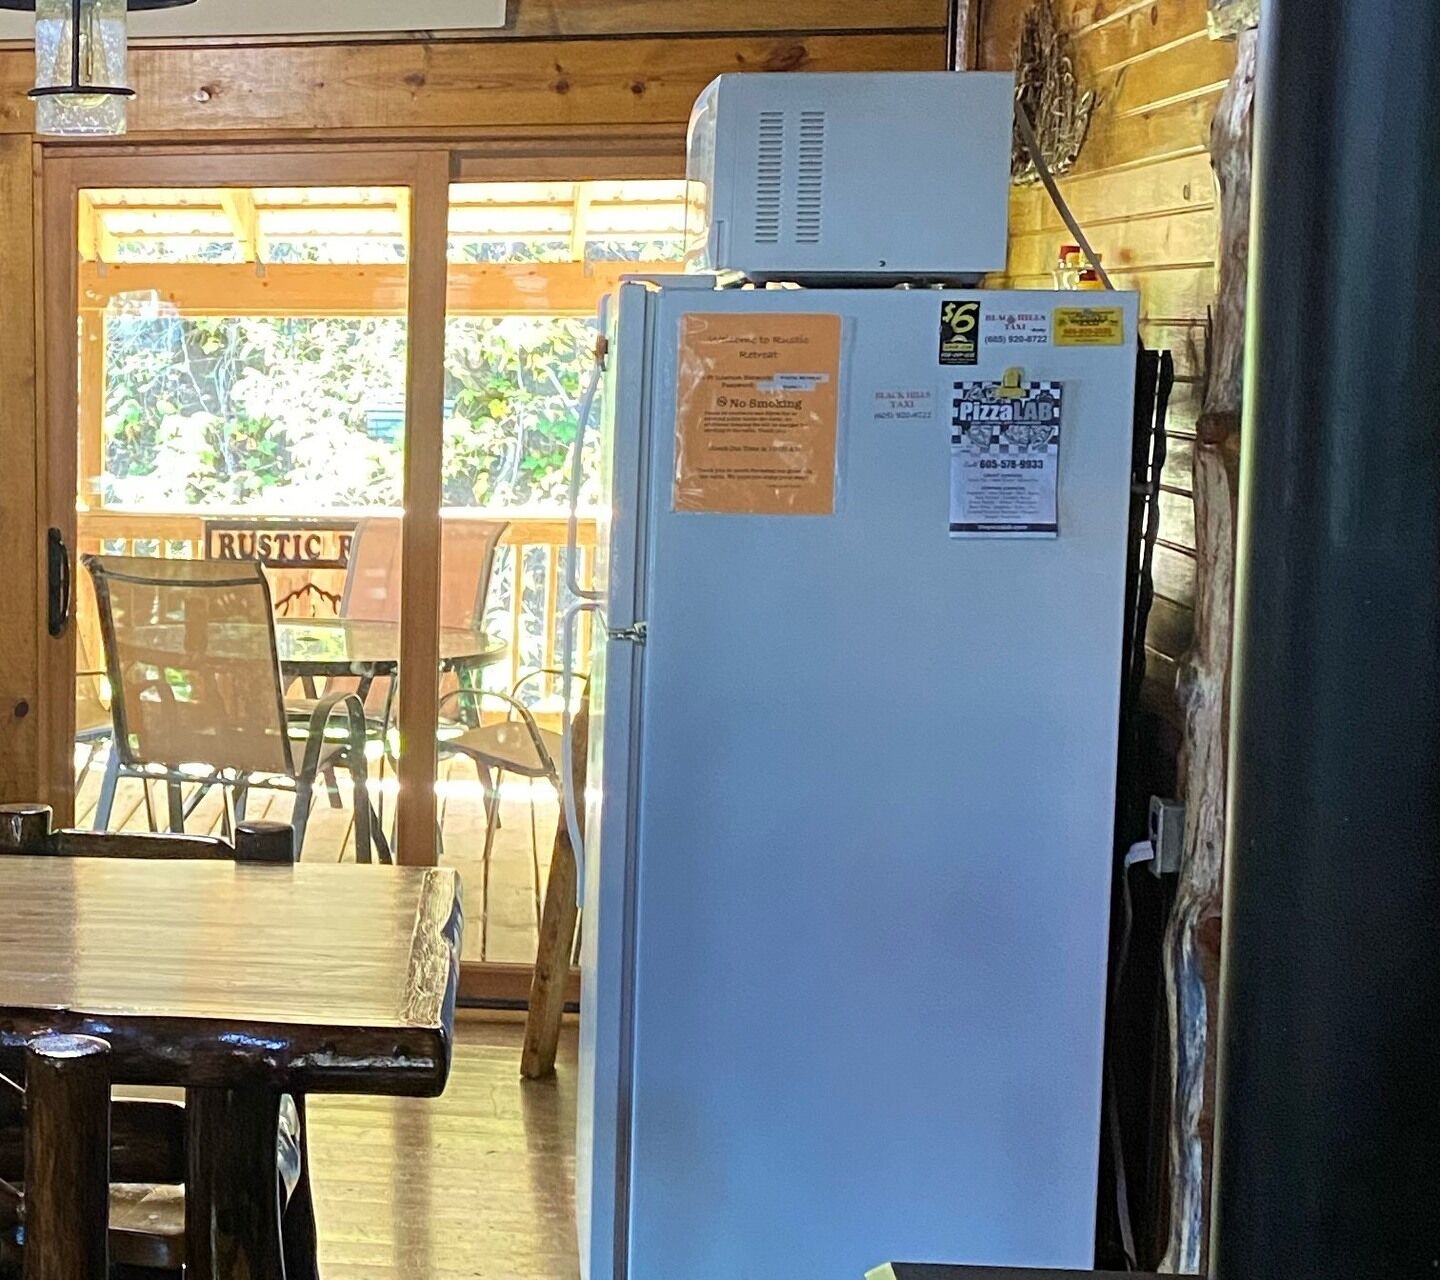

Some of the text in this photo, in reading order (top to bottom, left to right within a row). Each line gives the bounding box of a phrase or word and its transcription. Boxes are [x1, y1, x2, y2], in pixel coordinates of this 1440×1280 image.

[729, 398, 803, 410] No Smoking
[889, 400, 914, 408] TAXI
[218, 532, 322, 560] RUSTIC
